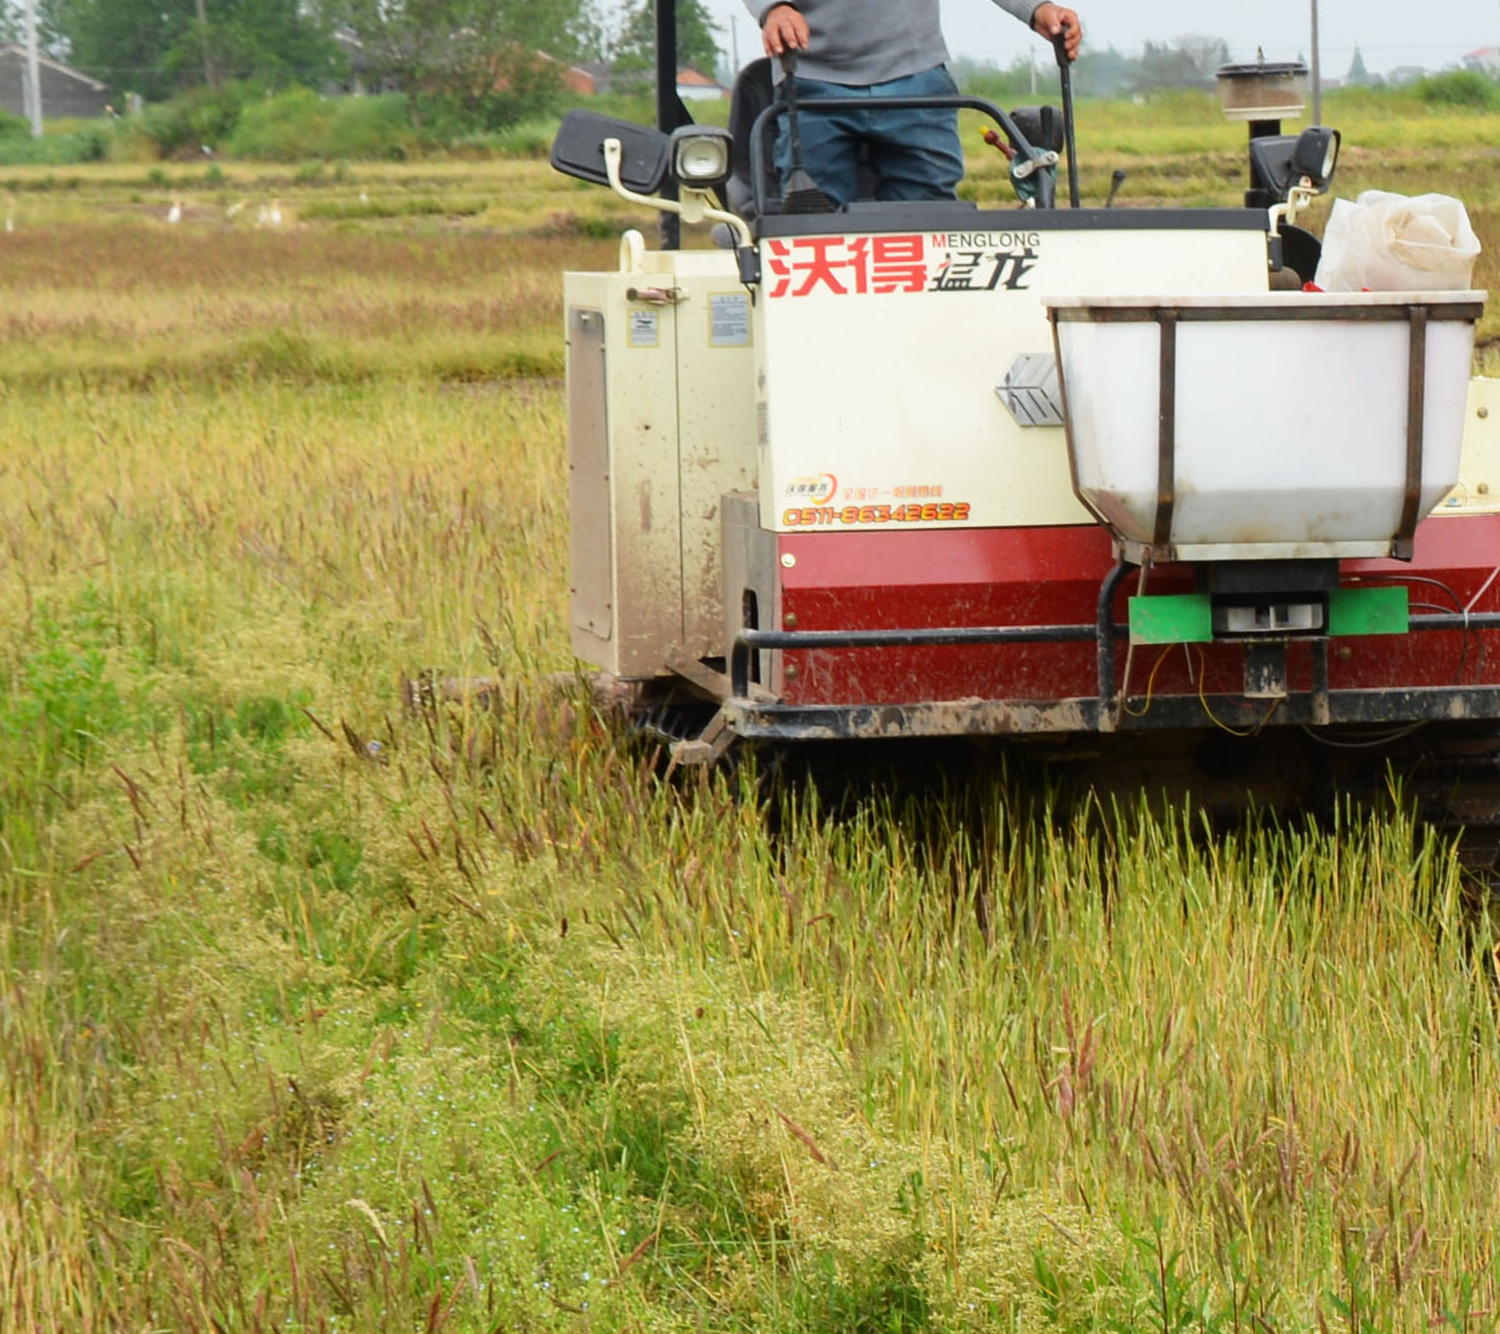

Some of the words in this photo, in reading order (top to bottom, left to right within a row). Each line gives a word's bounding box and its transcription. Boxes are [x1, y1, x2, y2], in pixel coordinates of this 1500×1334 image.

[932, 232, 1041, 249] MENGLONG
[768, 235, 928, 298] 沃得
[927, 248, 1040, 292] 猛龙
[782, 502, 971, 526] 0511-86342622
